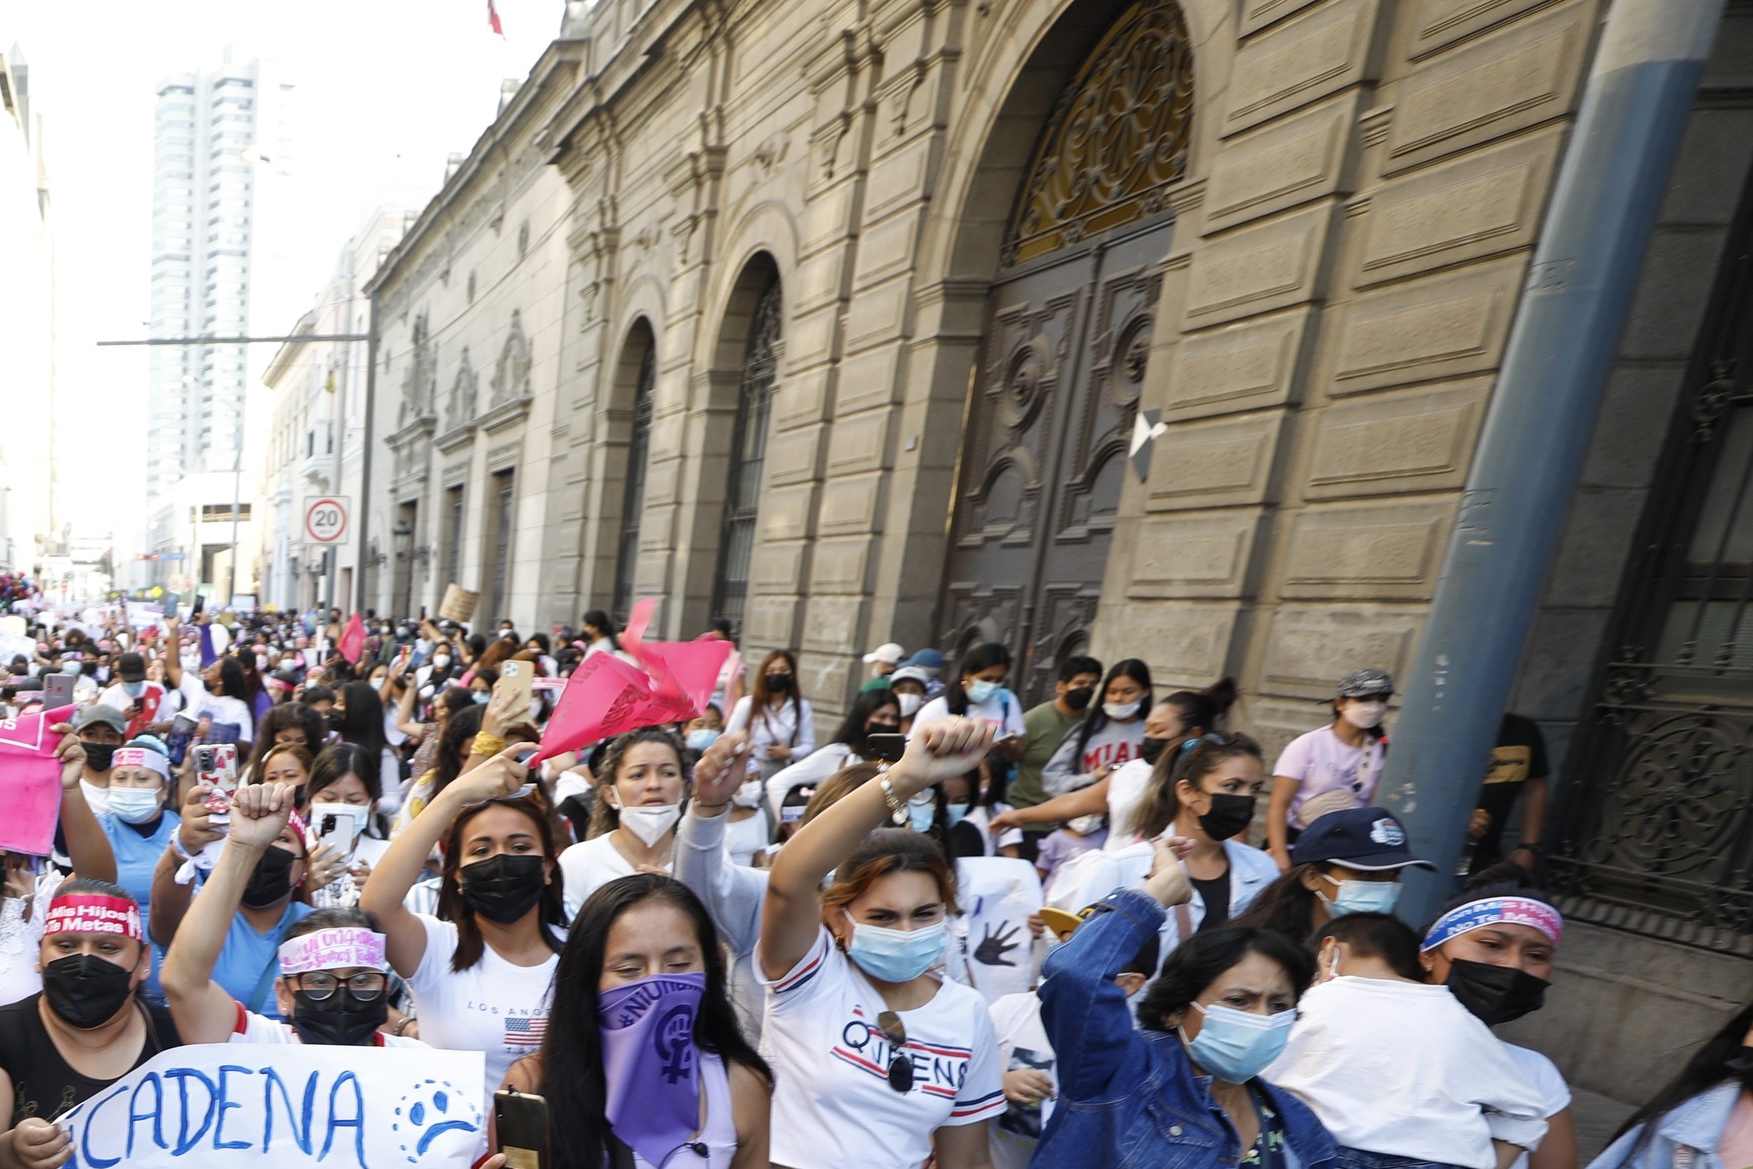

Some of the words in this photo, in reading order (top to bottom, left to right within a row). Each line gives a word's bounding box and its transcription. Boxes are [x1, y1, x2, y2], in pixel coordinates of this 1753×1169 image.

[315, 509, 339, 527] 20
[77, 905, 129, 922] Hijos
[62, 917, 125, 934] Metas
[467, 1001, 499, 1014] LOS
